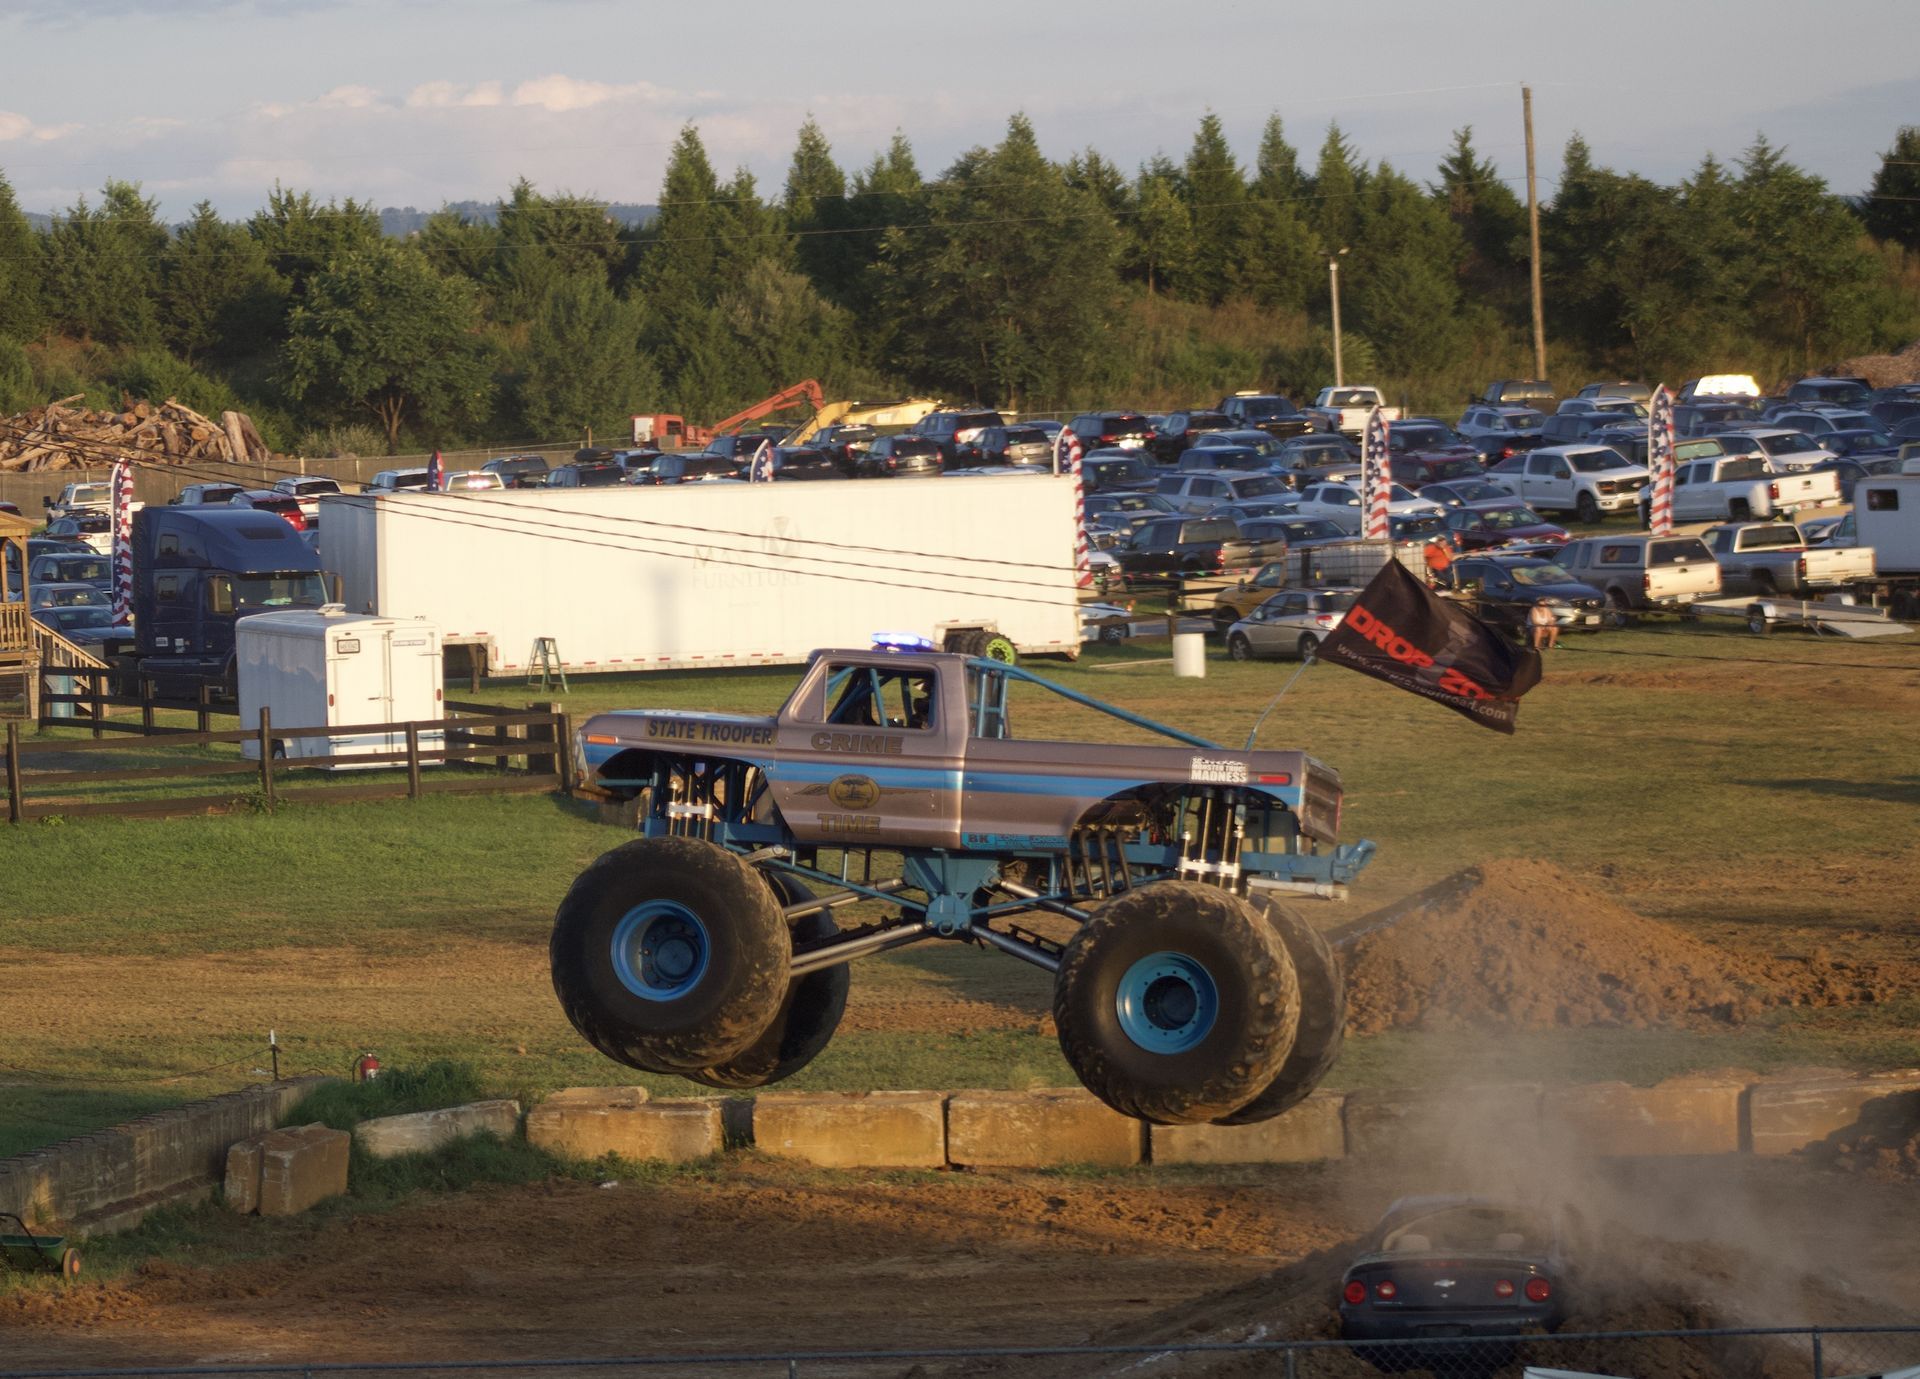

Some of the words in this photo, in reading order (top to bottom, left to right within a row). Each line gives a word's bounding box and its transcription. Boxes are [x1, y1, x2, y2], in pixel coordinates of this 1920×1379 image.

[1344, 604, 1435, 669] DROP
[648, 719, 697, 740] STATE
[701, 723, 773, 745] TROOPER
[810, 732, 905, 755] CRIME
[1191, 770, 1247, 783] MADNESS
[817, 812, 881, 835] TIME
